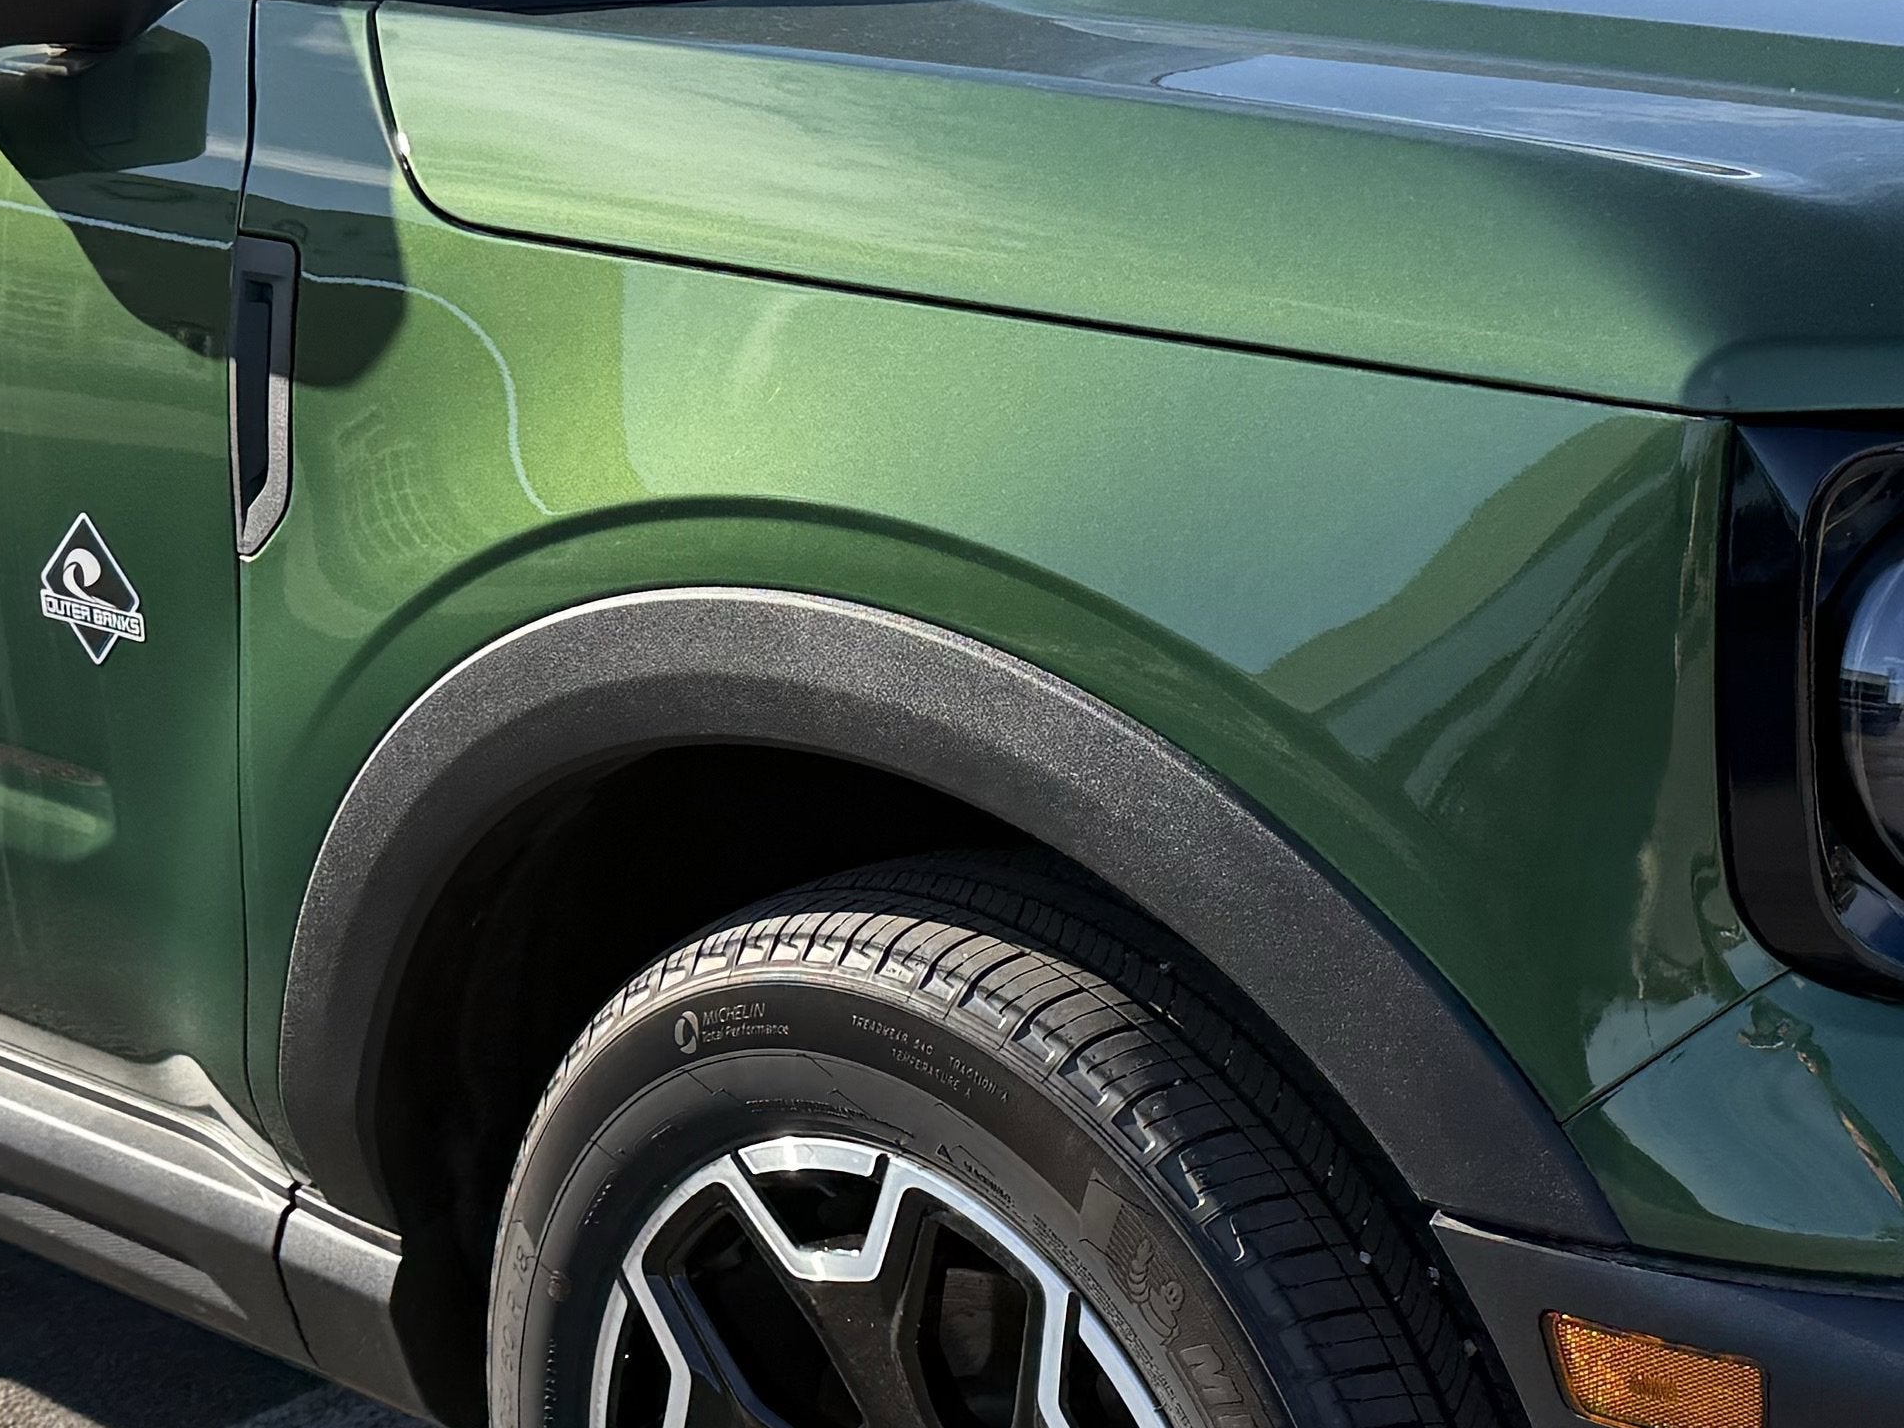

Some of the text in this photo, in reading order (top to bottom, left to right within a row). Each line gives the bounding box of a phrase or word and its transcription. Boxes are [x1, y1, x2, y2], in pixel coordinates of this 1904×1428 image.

[46, 596, 140, 635] OUTER BANKS
[702, 1002, 767, 1026] MICHELIN
